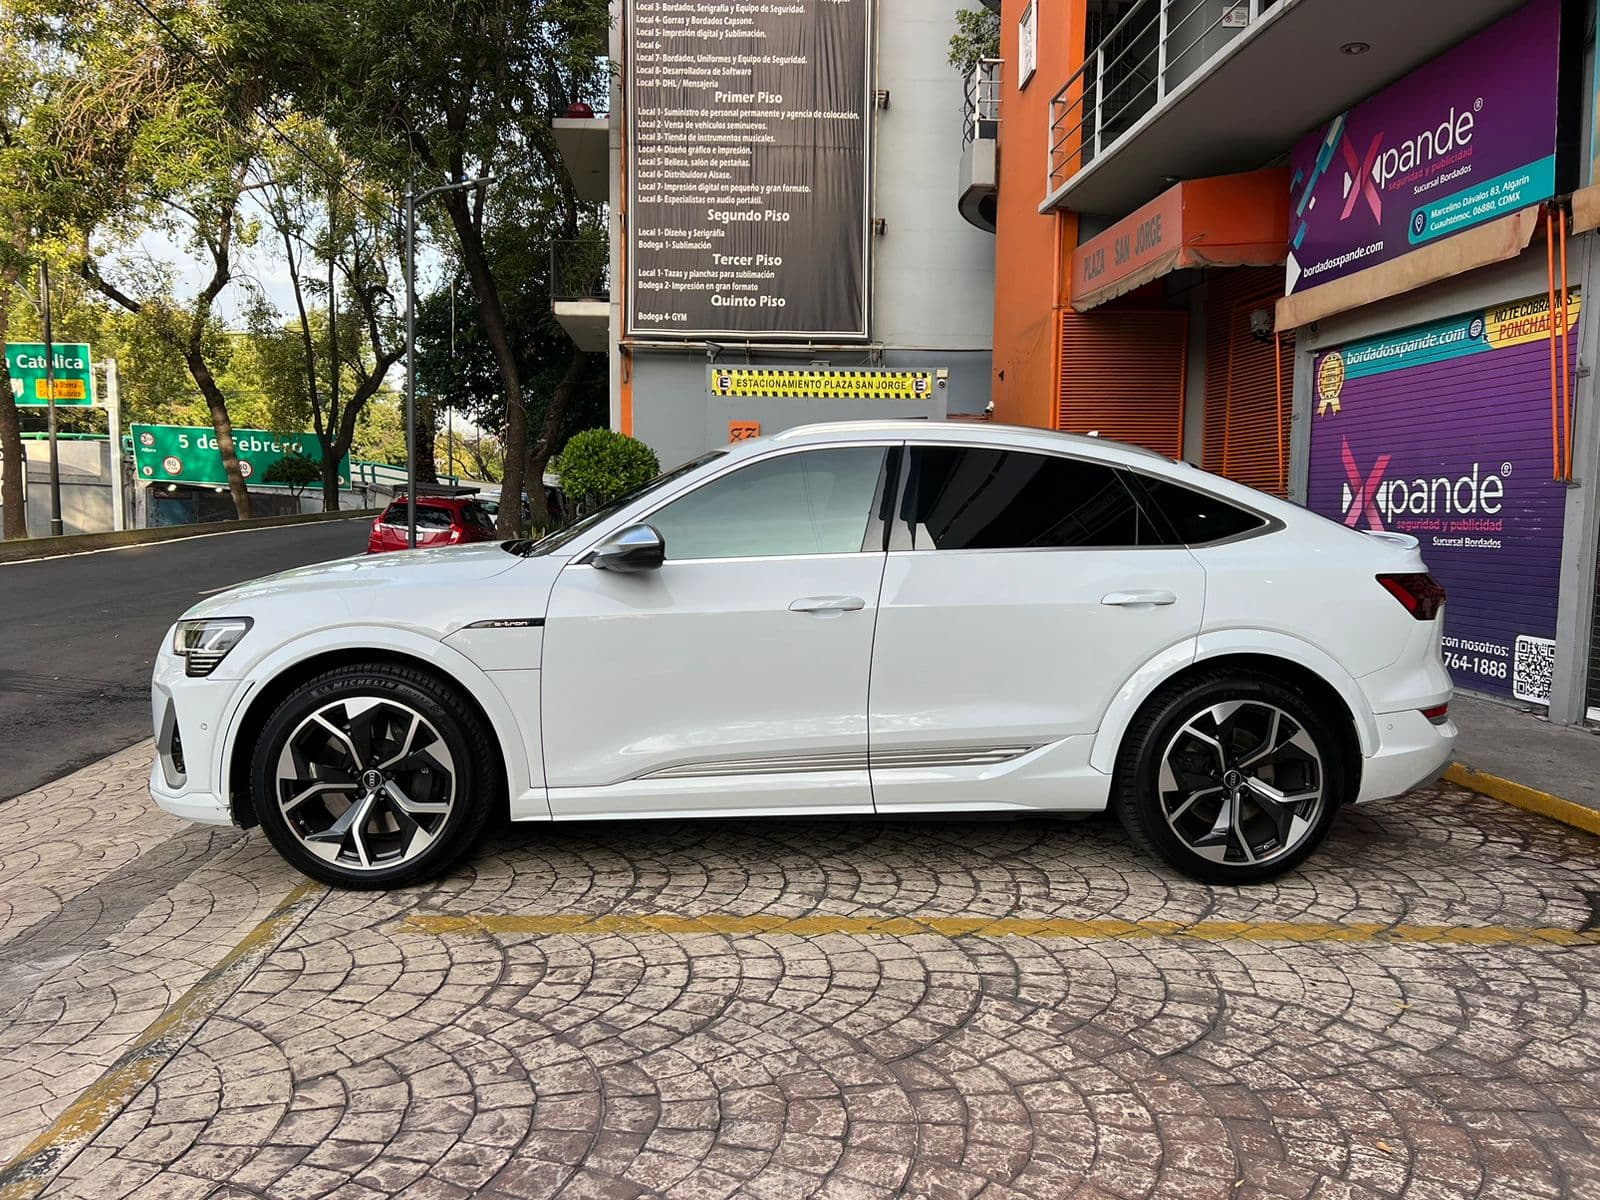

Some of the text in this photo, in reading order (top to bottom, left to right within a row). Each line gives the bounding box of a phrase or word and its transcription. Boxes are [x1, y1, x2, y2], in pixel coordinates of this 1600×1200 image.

[662, 3, 695, 12] Bordados,
[730, 6, 735, 14] y
[736, 4, 760, 14] Equipo
[770, 5, 805, 15] Seguridad.
[636, 15, 654, 23] Local
[662, 16, 684, 24] Gorras
[685, 18, 689, 26] y
[691, 16, 722, 25] Bordados
[636, 28, 767, 40] Local Impresión digital y Sublimación.
[636, 40, 654, 48] Local
[636, 53, 807, 66] Local Bordados, Uniformes y Equipo de Seguridad.
[636, 66, 752, 76] Local Desarrolladora de Software
[636, 78, 654, 87] Local
[663, 79, 677, 87] DHL
[715, 91, 783, 103] Primer Piso
[638, 107, 655, 116] Local
[664, 108, 699, 116] Suministro
[700, 108, 709, 116] de
[710, 109, 738, 118] personal
[740, 110, 780, 119] permanente
[780, 111, 785, 120] y
[786, 110, 812, 120] agencia
[823, 110, 859, 119] colocación.
[638, 120, 655, 128] Local
[664, 120, 684, 128] Venta
[727, 121, 767, 130] seminuevos.
[638, 132, 776, 142] Local Tienda de instrumentos musicales.
[638, 145, 655, 153] Local
[664, 145, 687, 154] Diseño
[718, 146, 752, 156] impresión.
[638, 157, 655, 166] Local
[664, 158, 690, 167] Belleza,
[691, 158, 708, 166] salón
[1388, 167, 1423, 191] seguridad
[1431, 145, 1473, 174] publicidad
[638, 170, 655, 178] Local
[1413, 164, 1472, 195] Sucursal Bordados
[638, 182, 655, 191] Local
[664, 183, 697, 193] Impresión
[698, 183, 720, 193] digital
[730, 184, 759, 194] pequeño
[760, 186, 765, 194] y
[766, 186, 781, 194] gran
[782, 184, 811, 193] formato.
[638, 195, 655, 203] Local
[664, 195, 705, 206] Especialistas
[716, 196, 735, 204] audio
[1473, 202, 1496, 216] 06880,
[1498, 191, 1520, 207] CDMX
[1430, 200, 1461, 218] Marcelino
[707, 209, 790, 224] Segundo Piso
[638, 228, 655, 236] Local
[664, 228, 687, 237] Diseño
[688, 231, 692, 239] y
[638, 240, 663, 251] Bodega
[672, 241, 711, 249] Sublimación
[1084, 212, 1162, 281] PLAZA SAN JORGE
[712, 253, 782, 266] Tercer Piso
[1303, 240, 1384, 278] bordadosxpande.com
[638, 269, 655, 277] Local
[664, 269, 683, 278] Tazas
[683, 271, 688, 279] y
[689, 270, 718, 279] planchas
[720, 272, 734, 280] para
[736, 270, 775, 279] sublimación
[638, 281, 663, 291] Bodega
[672, 282, 704, 292] Impresión
[716, 284, 730, 292] gran
[732, 282, 758, 291] formato
[711, 295, 786, 307] Quinto Piso
[638, 312, 663, 322] Bodega
[672, 313, 687, 322] GYM
[1494, 308, 1506, 323] NO
[1506, 306, 1519, 320] TE
[1346, 328, 1466, 365] bordadosxpande.com
[16, 354, 83, 369] Catlica
[720, 377, 729, 388] E
[736, 379, 906, 390] ESTACIONAMIENTO PLAZA SAN JORGE
[915, 381, 924, 391] E
[178, 434, 189, 448] 5
[197, 434, 219, 450] de
[1397, 519, 1502, 532] seguridad y publicidad
[1433, 536, 1502, 549] Sucursal Bordados
[1441, 636, 1510, 657] con nosotros:
[1444, 652, 1507, 679] 764-1888
[333, 679, 396, 689] MICHELIN
